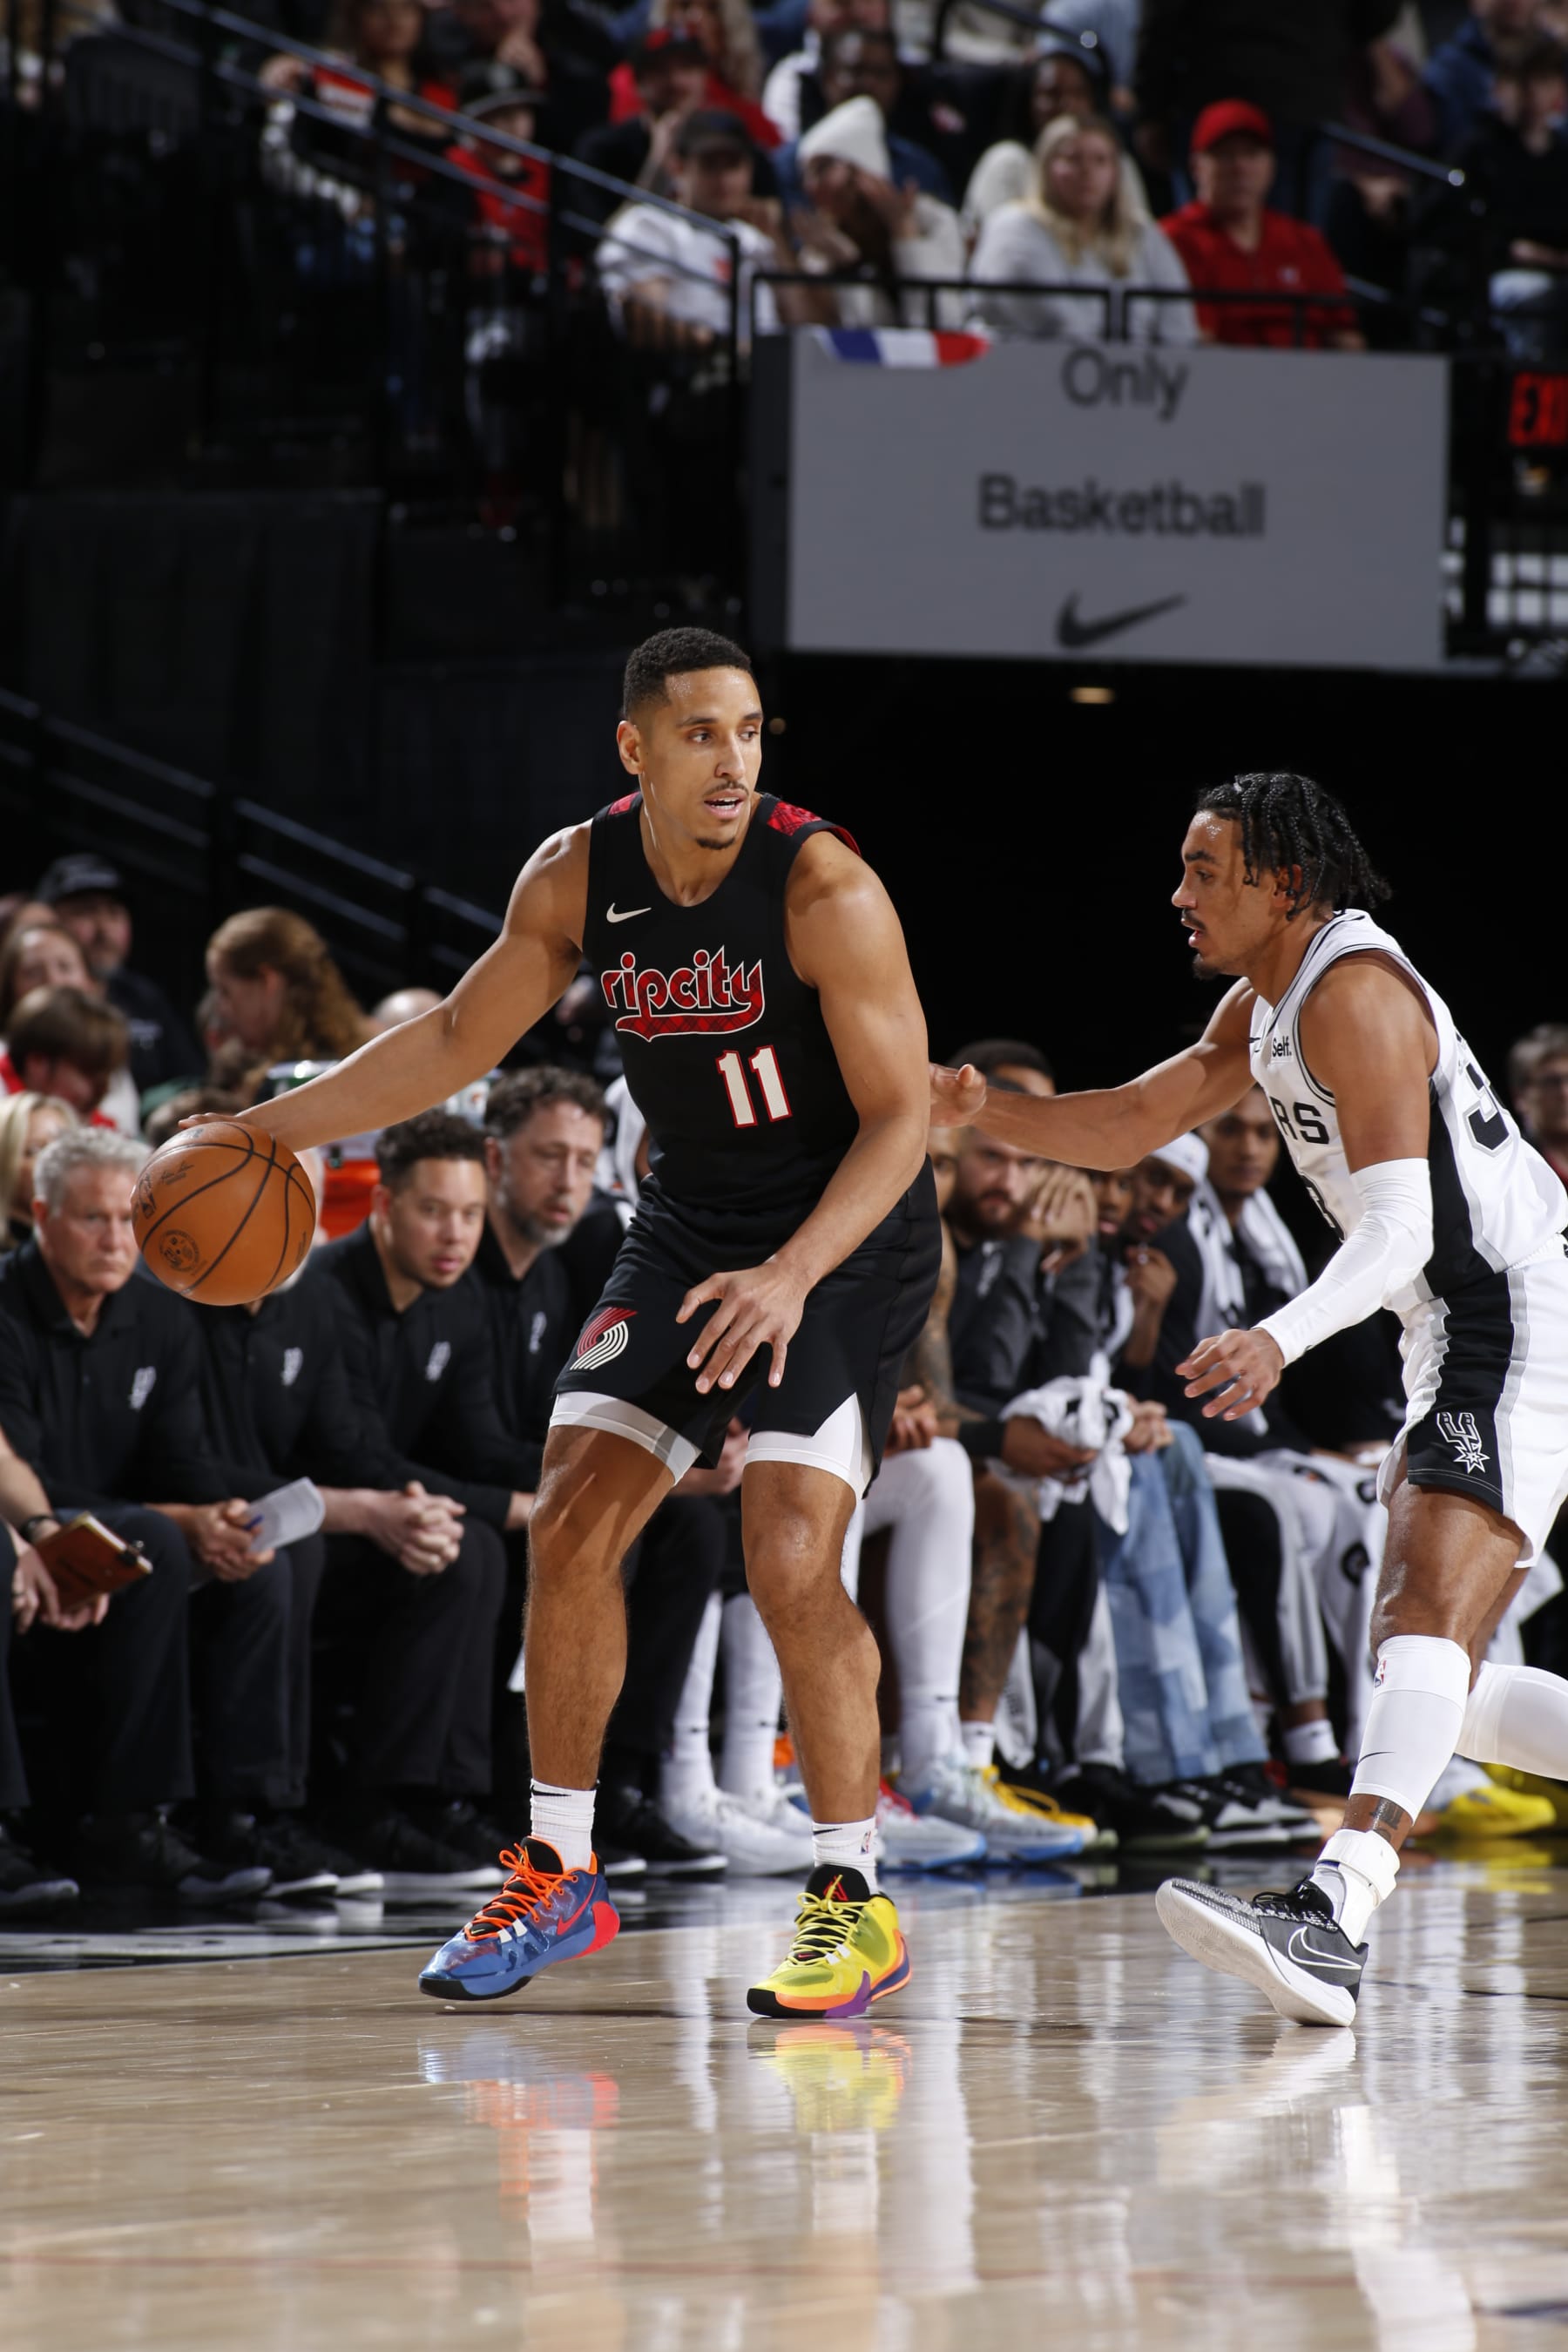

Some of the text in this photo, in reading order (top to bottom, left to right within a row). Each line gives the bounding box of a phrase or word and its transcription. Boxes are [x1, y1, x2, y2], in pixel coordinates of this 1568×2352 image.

[1062, 348, 1190, 423] Only
[979, 472, 1266, 537] Basketball
[601, 945, 765, 1042] ripcity
[1272, 1036, 1292, 1057] Self.
[715, 1044, 793, 1128] 11
